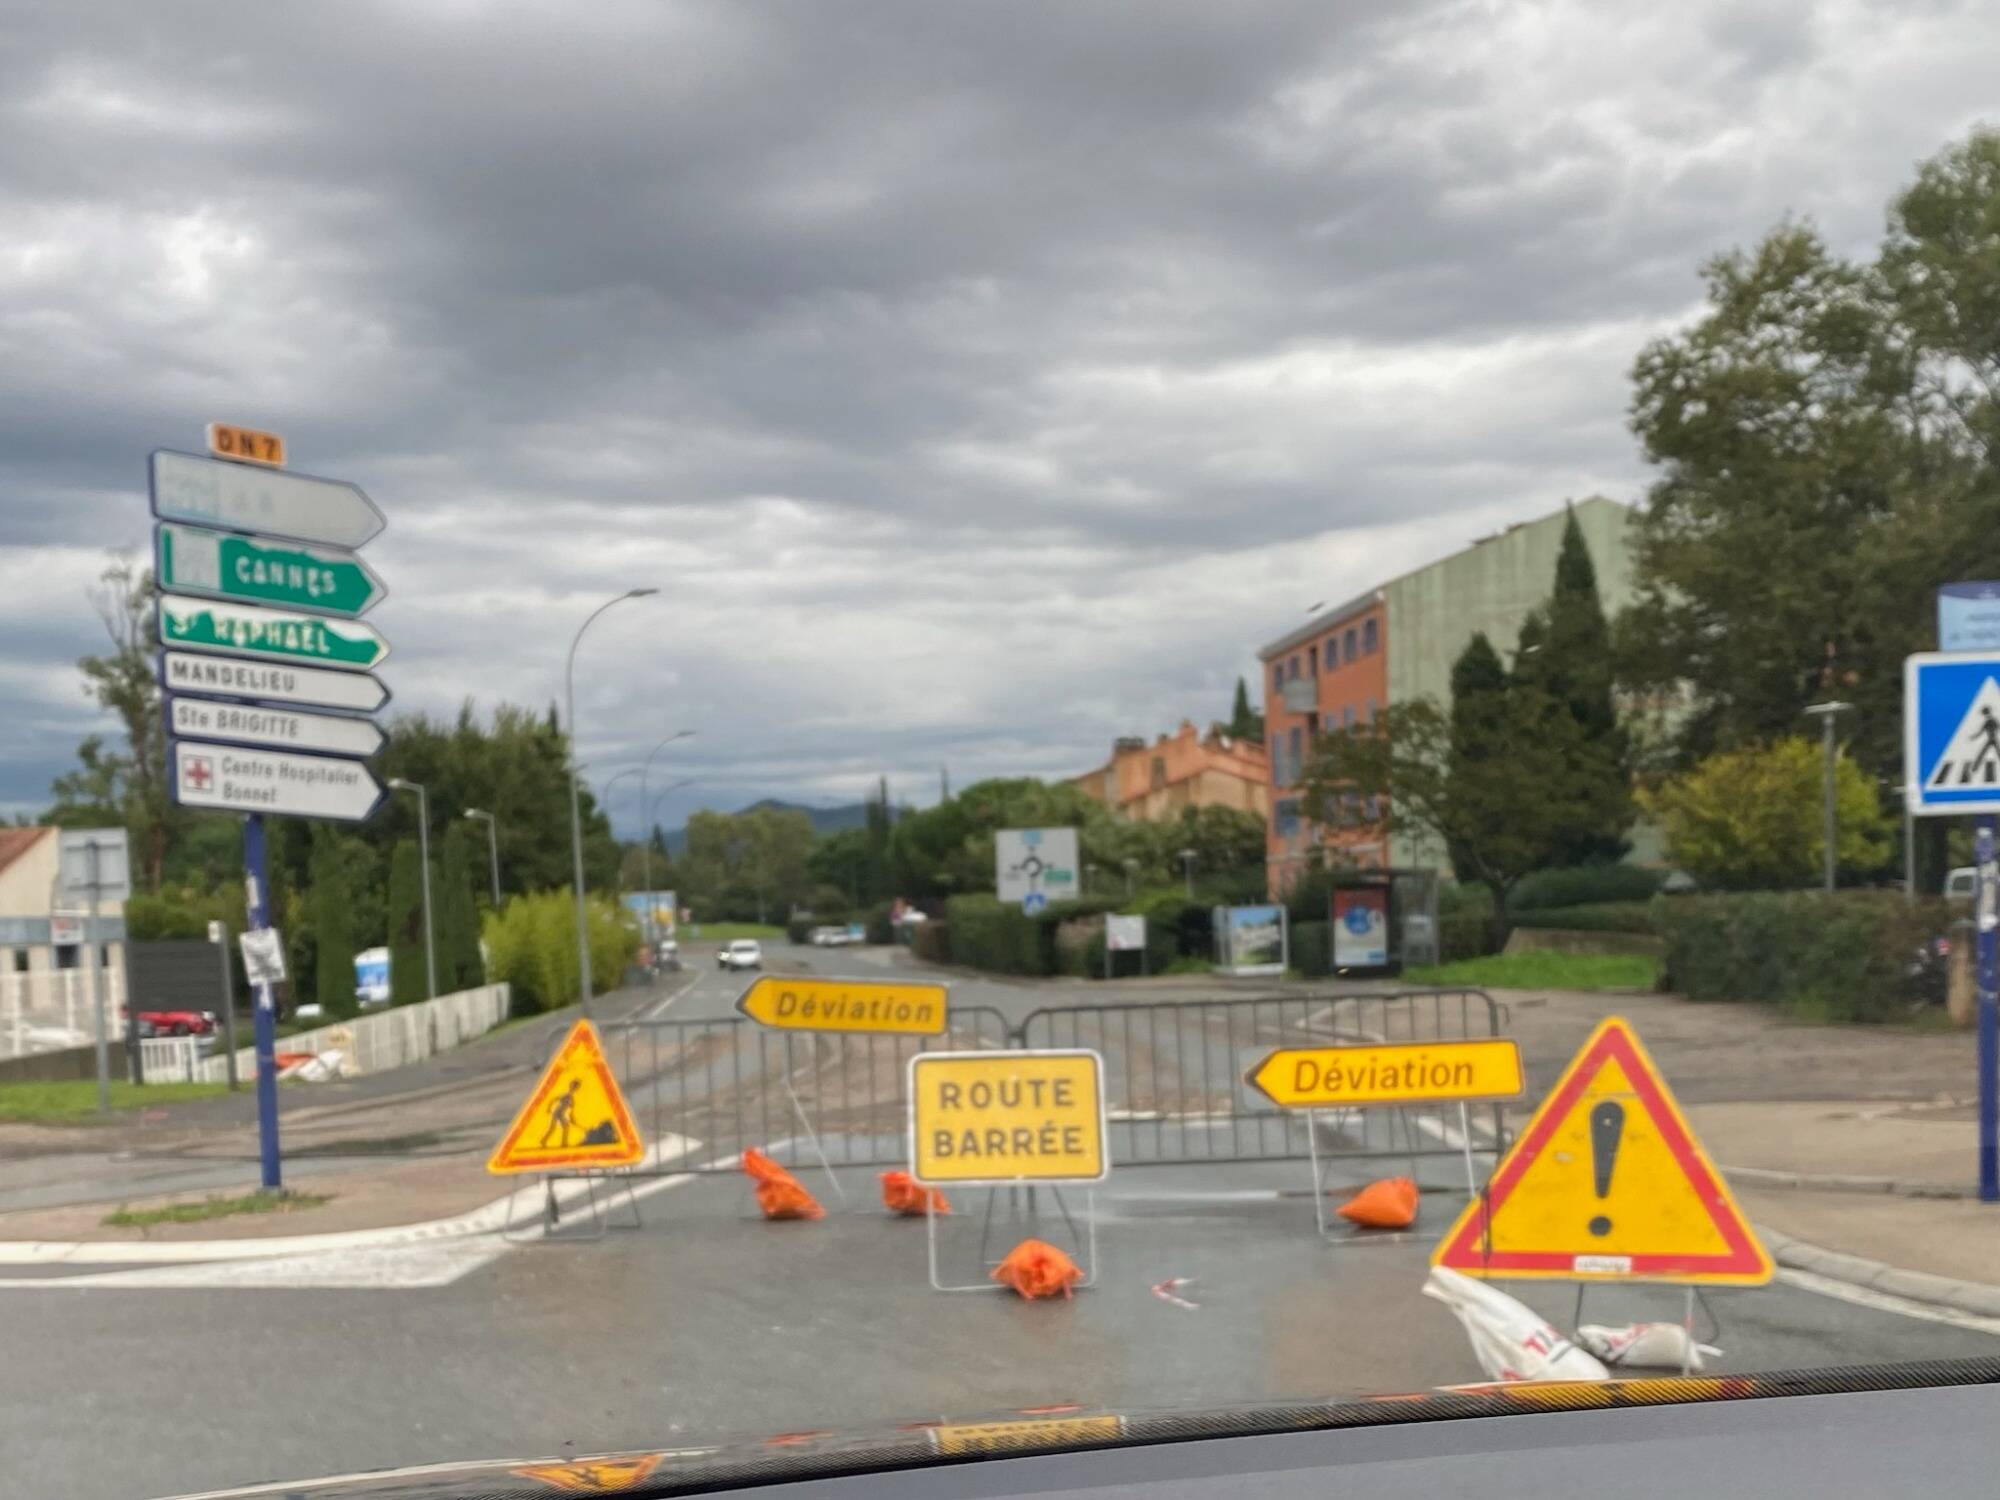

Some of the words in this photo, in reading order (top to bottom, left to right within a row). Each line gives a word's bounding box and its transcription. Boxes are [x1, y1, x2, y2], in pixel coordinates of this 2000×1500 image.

[235, 555, 337, 596] CANNES
[172, 661, 295, 692] MANDELIEU
[178, 705, 209, 727] Ste
[216, 709, 299, 738] BRIGITTE
[221, 756, 273, 778] Centre
[279, 761, 359, 786] Hospitalier
[222, 781, 277, 803] Bonnet
[775, 992, 933, 1023] Déviation
[1292, 1053, 1474, 1093] Déviation
[938, 1078, 1074, 1110] ROUTE
[933, 1120, 1085, 1158] BARRÉE
